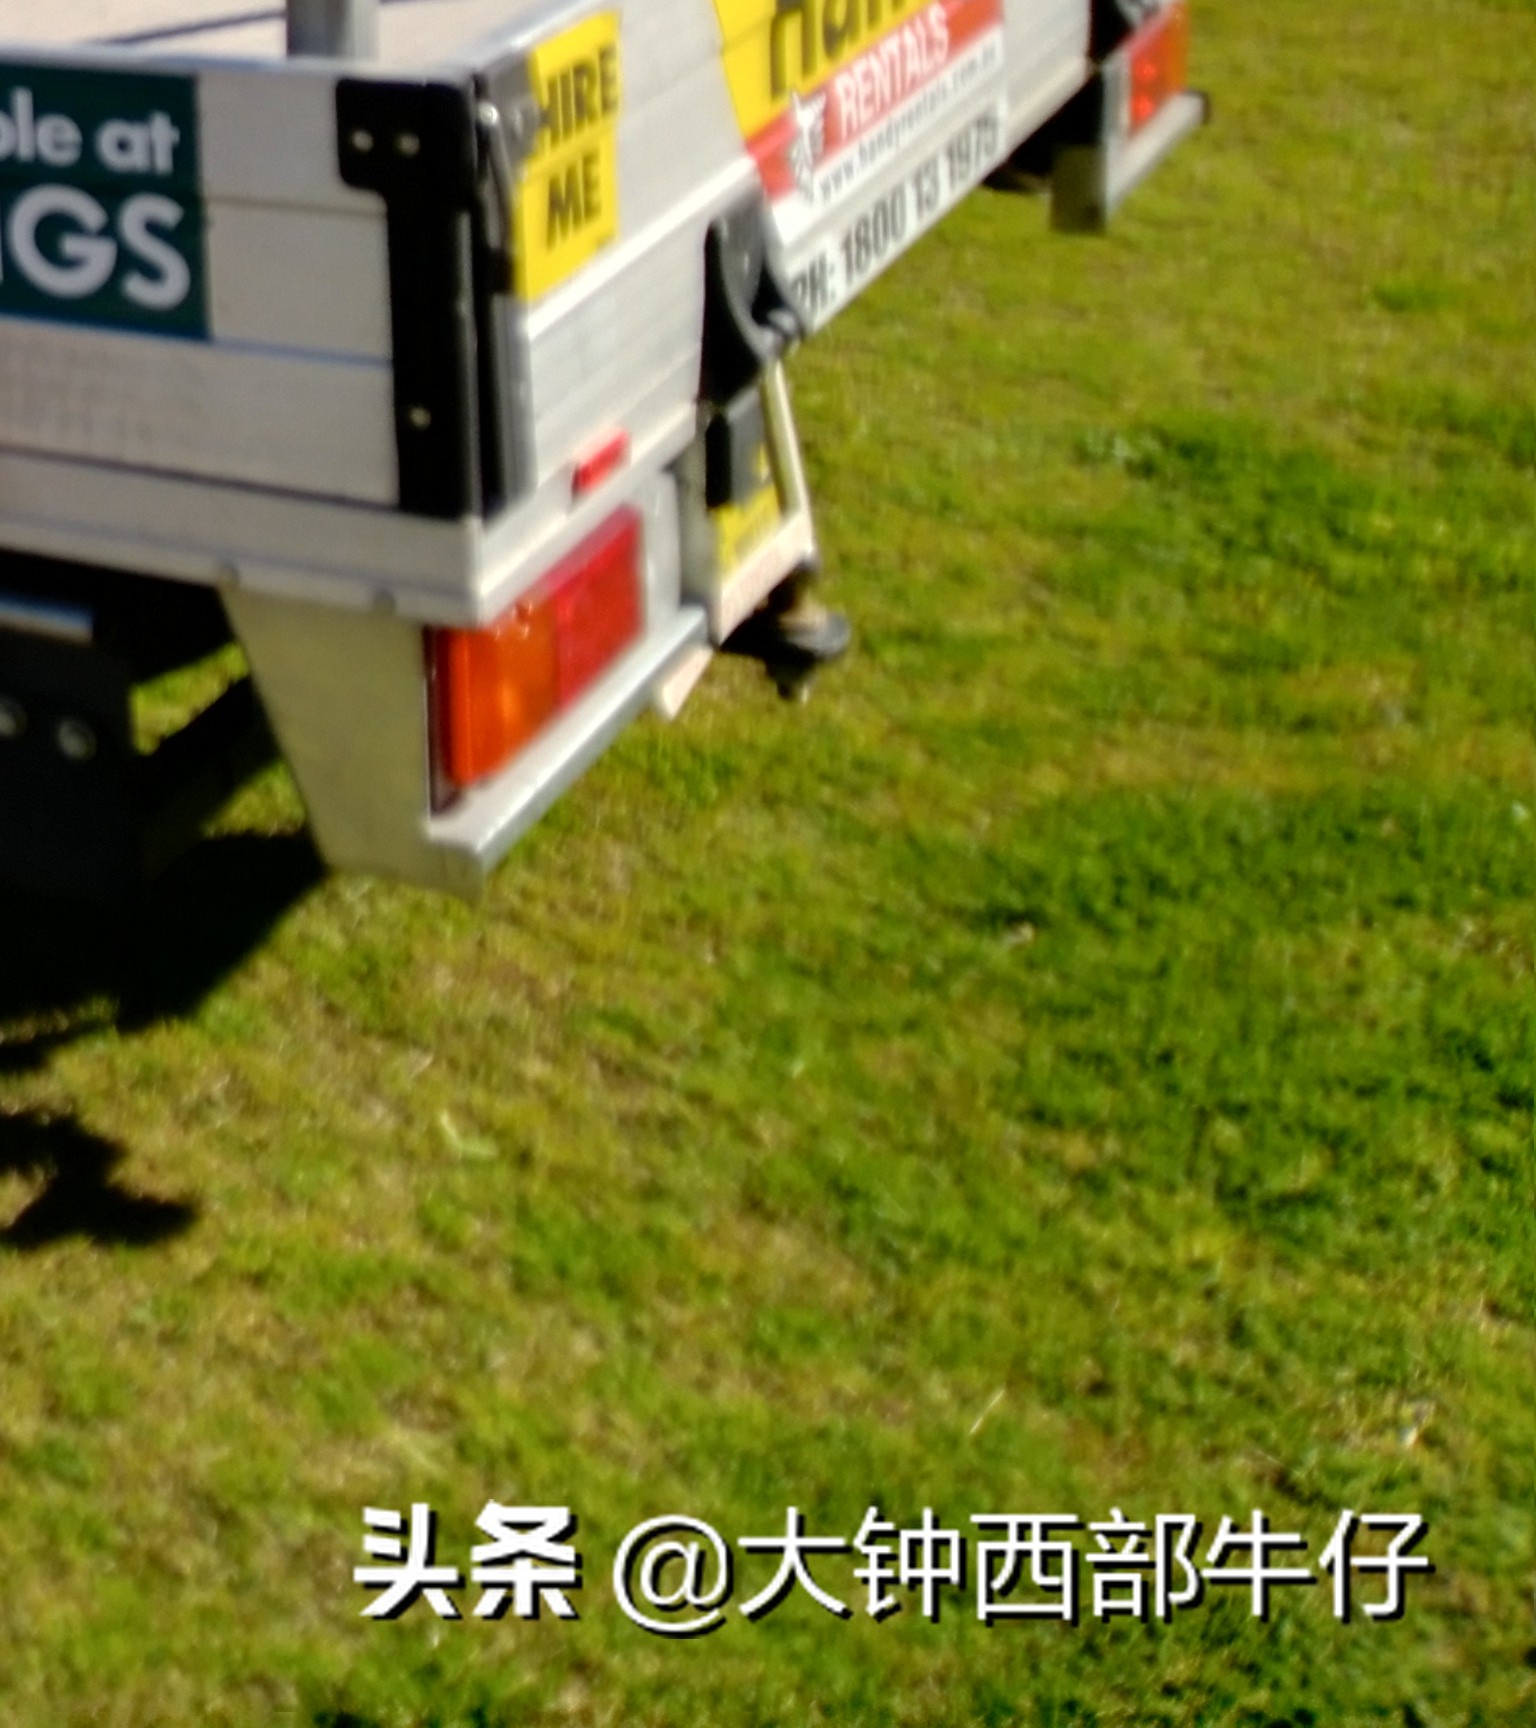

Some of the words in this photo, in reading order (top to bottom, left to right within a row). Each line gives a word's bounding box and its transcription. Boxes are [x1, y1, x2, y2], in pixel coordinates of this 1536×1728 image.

[835, 0, 950, 144] RENTALS
[94, 110, 182, 176] at
[546, 148, 602, 253] ME
[842, 180, 906, 287] 1800
